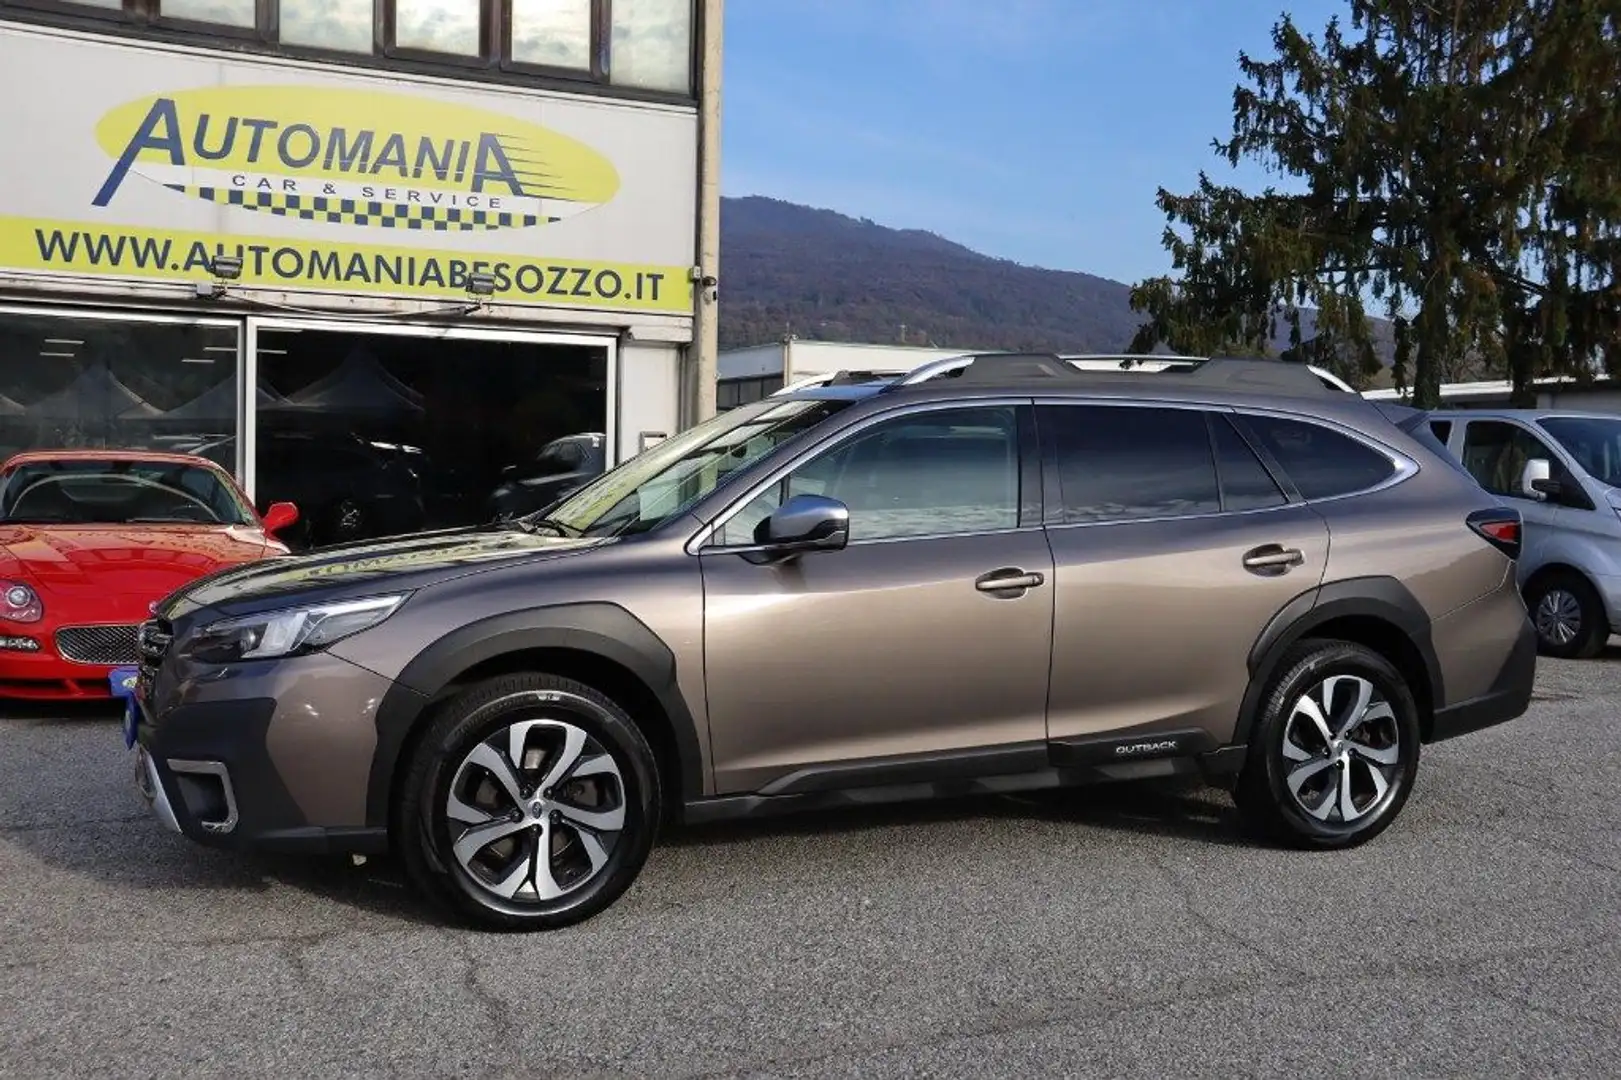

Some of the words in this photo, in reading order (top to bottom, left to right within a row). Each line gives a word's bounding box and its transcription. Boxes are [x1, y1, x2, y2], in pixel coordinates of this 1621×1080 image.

[91, 98, 524, 207] AUTOMANIA
[232, 175, 296, 191] CAR
[322, 183, 337, 195] &
[362, 186, 501, 209] SERVICE
[1115, 740, 1177, 754] OUTBACK
